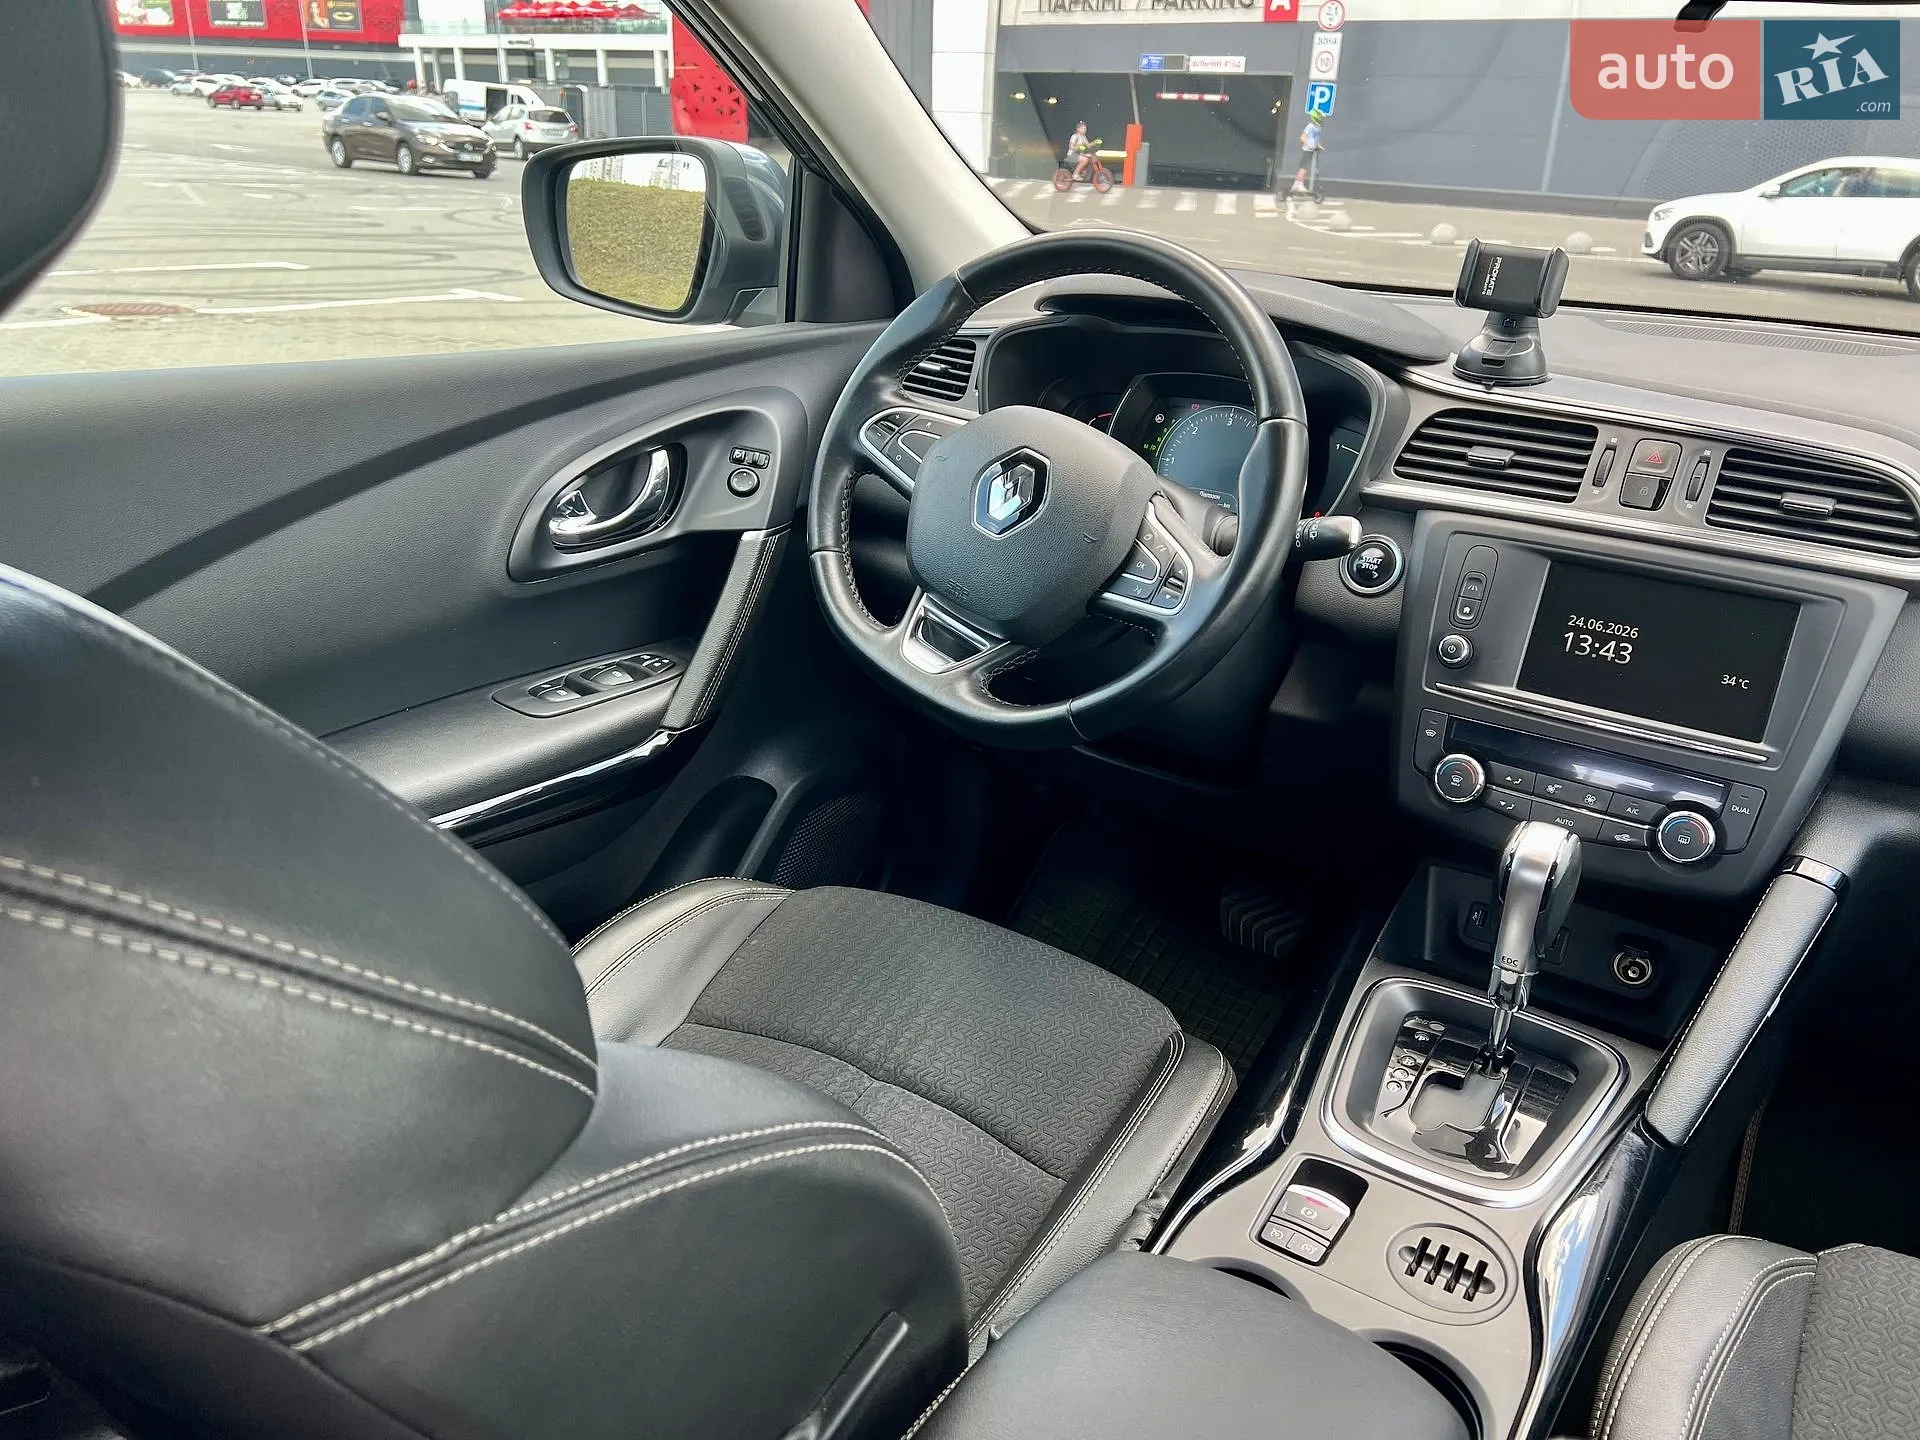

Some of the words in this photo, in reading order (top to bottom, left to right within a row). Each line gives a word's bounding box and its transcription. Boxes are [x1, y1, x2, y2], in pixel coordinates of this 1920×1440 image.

[1312, 86, 1331, 111] P
[1361, 556, 1383, 565] START
[1361, 563, 1379, 571] STOP
[1567, 614, 1639, 639] 24.06.2026
[1563, 631, 1633, 664] 13:43
[1720, 674, 1737, 687] 34
[1625, 805, 1640, 816] A/C
[1731, 804, 1751, 815] DUAL
[1555, 817, 1574, 827] AUTO
[1502, 955, 1519, 966] EDC
